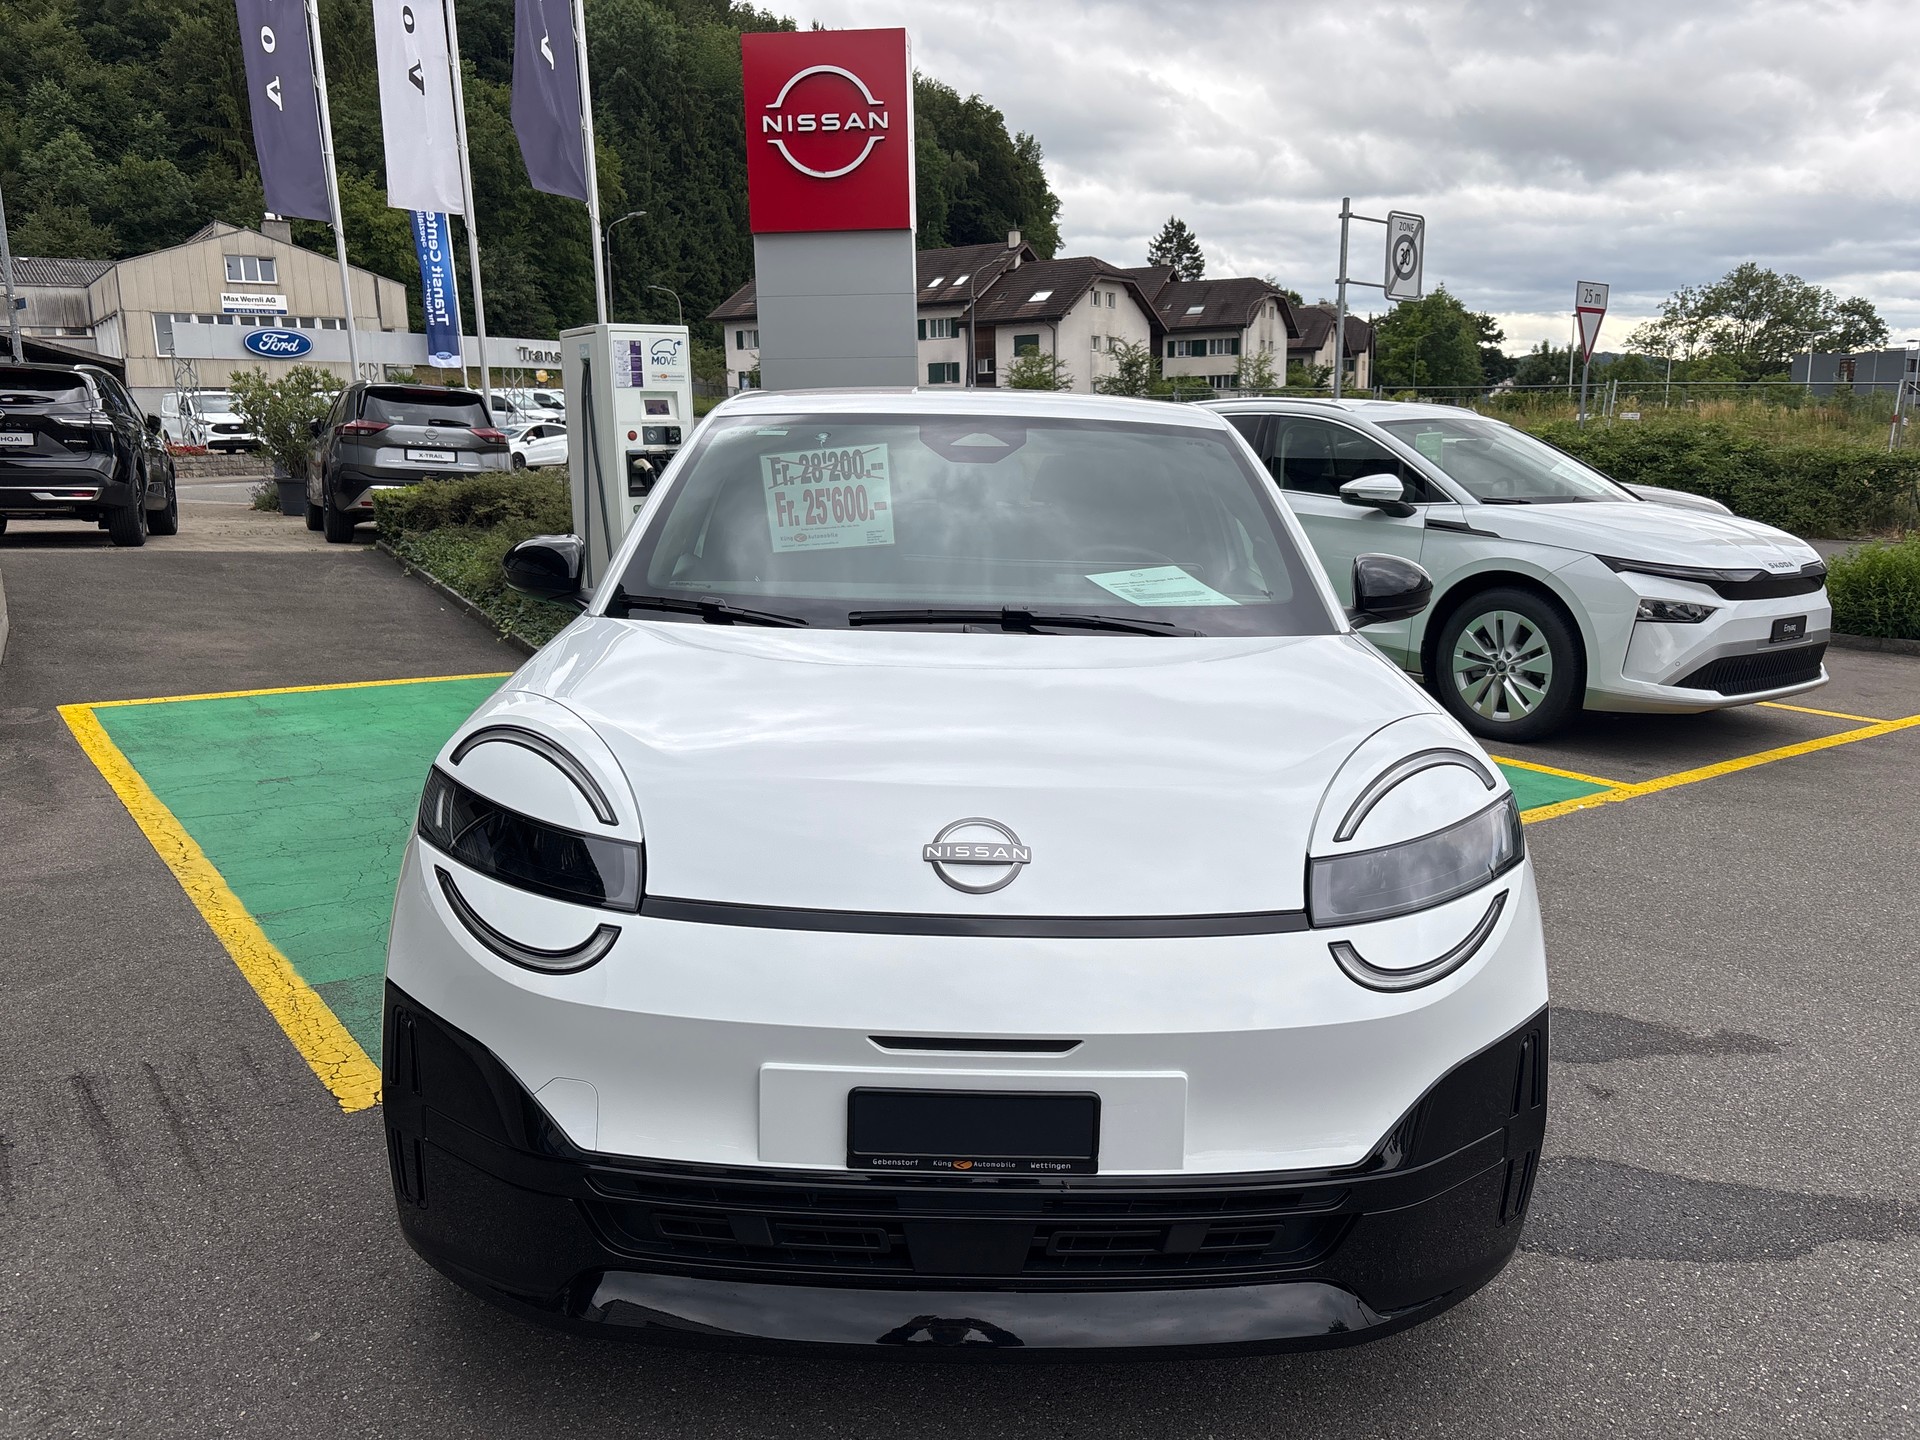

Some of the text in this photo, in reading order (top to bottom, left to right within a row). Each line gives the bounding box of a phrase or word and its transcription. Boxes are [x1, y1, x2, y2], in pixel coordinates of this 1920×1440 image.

[762, 111, 889, 133] NISSAN
[1398, 221, 1415, 232] ZONE
[1399, 248, 1411, 266] 30
[240, 296, 264, 304] Wernli
[1583, 288, 1602, 305] 25 m
[258, 332, 300, 352] Ford
[651, 356, 677, 366] MOVE
[775, 492, 799, 527] Fr.
[1783, 622, 1797, 633] Enyaq
[926, 845, 1028, 860] NISSAN
[872, 1158, 1072, 1171] Gebenstorf Küng Automobile Wettingen
